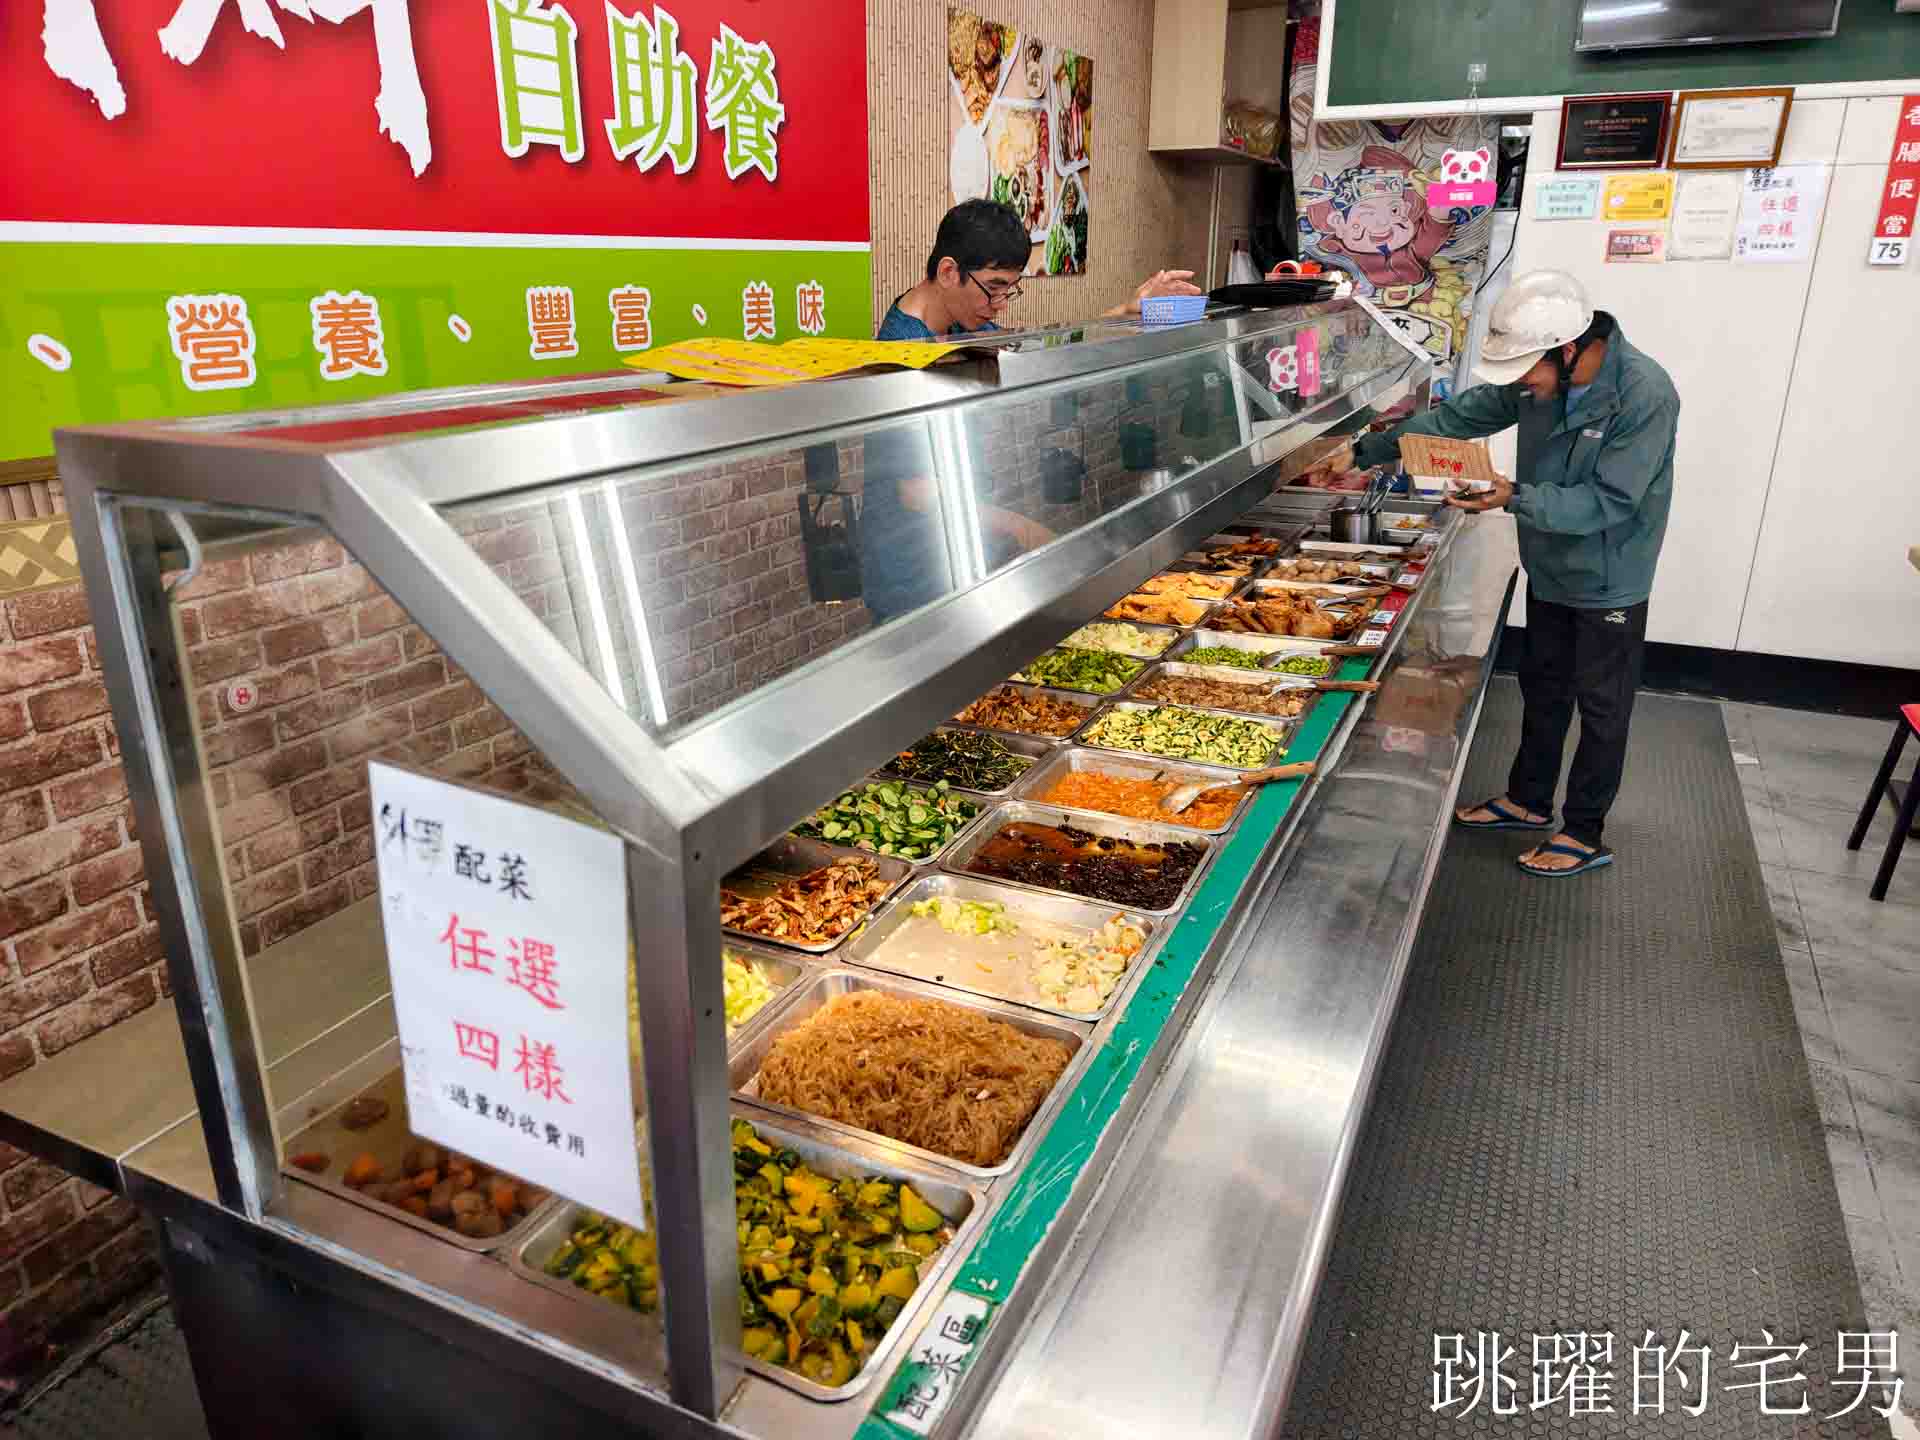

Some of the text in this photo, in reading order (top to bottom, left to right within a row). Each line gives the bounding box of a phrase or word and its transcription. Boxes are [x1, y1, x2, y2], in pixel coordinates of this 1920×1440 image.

[487, 0, 785, 182] 自助餐
[1877, 242, 1903, 259] 75
[439, 913, 567, 1011] 任選
[452, 1019, 576, 1105] 四樣
